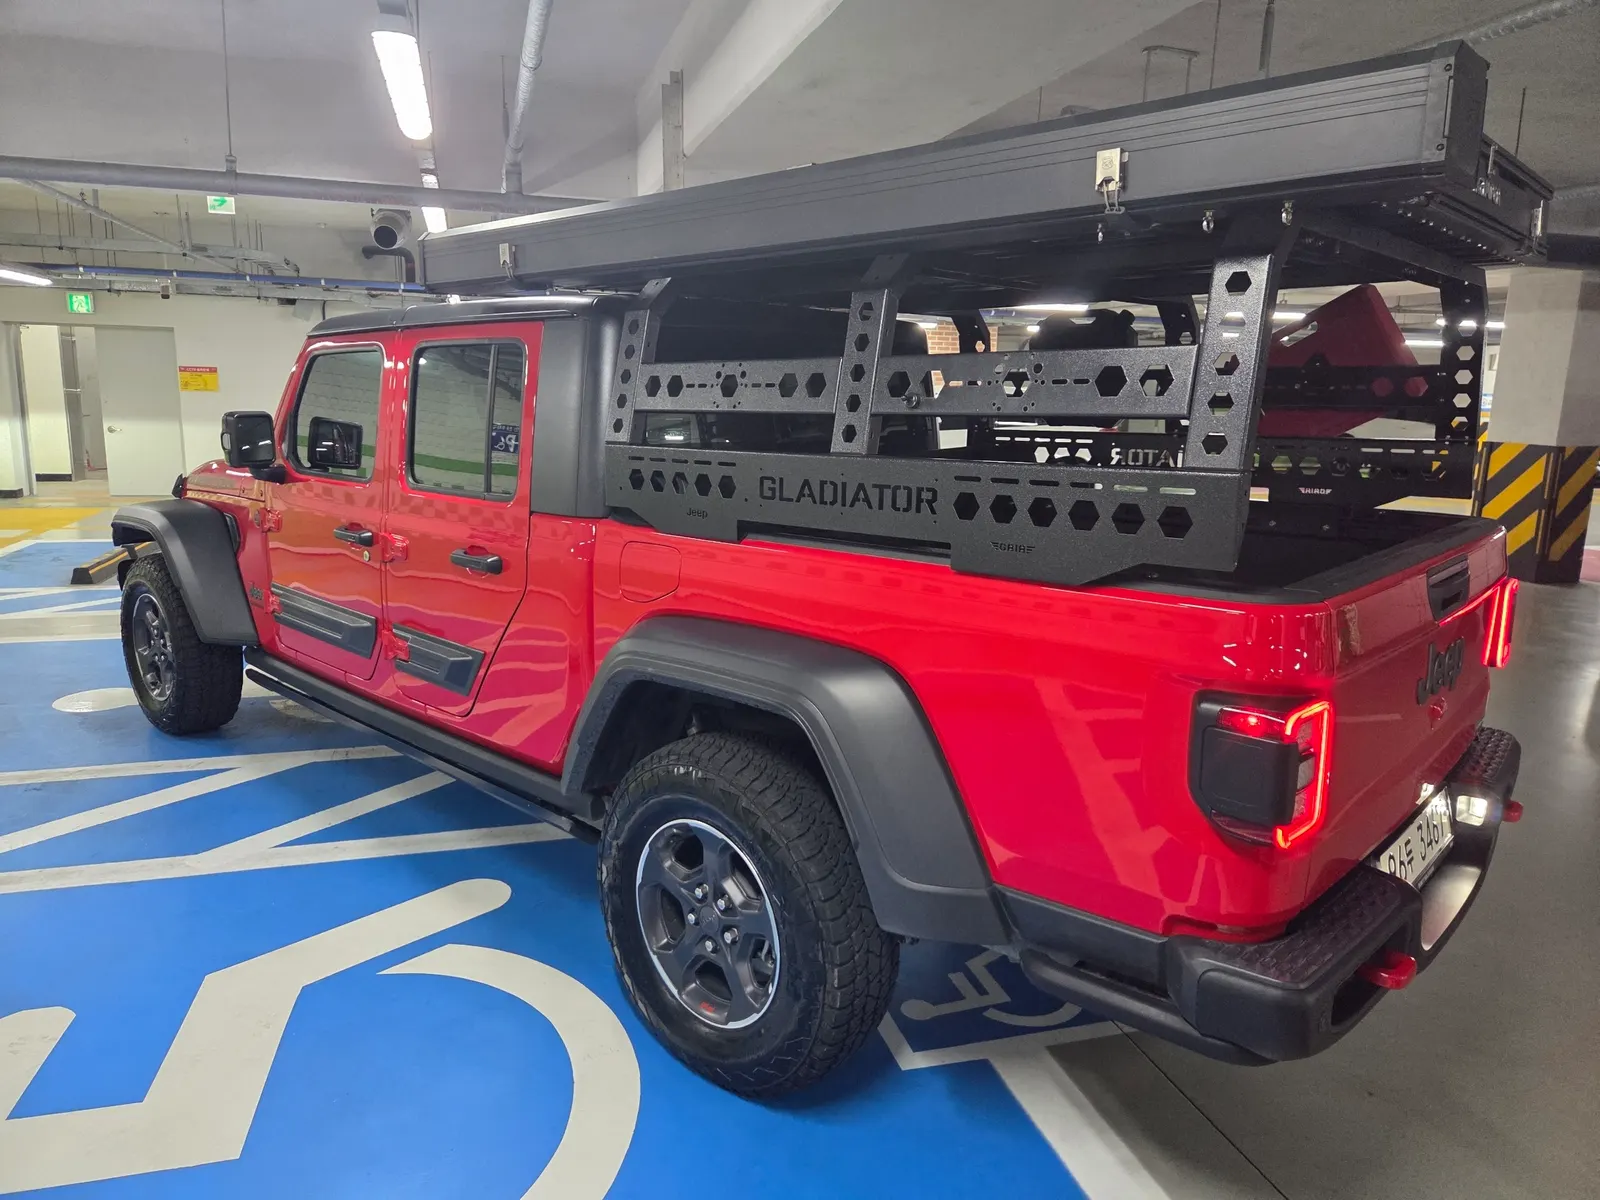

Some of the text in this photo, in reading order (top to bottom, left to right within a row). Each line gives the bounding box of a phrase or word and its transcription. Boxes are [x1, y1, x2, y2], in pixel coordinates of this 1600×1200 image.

[686, 507, 708, 520] Jeep
[759, 475, 938, 515] GLADIATOR
[1417, 638, 1465, 706] Jeep
